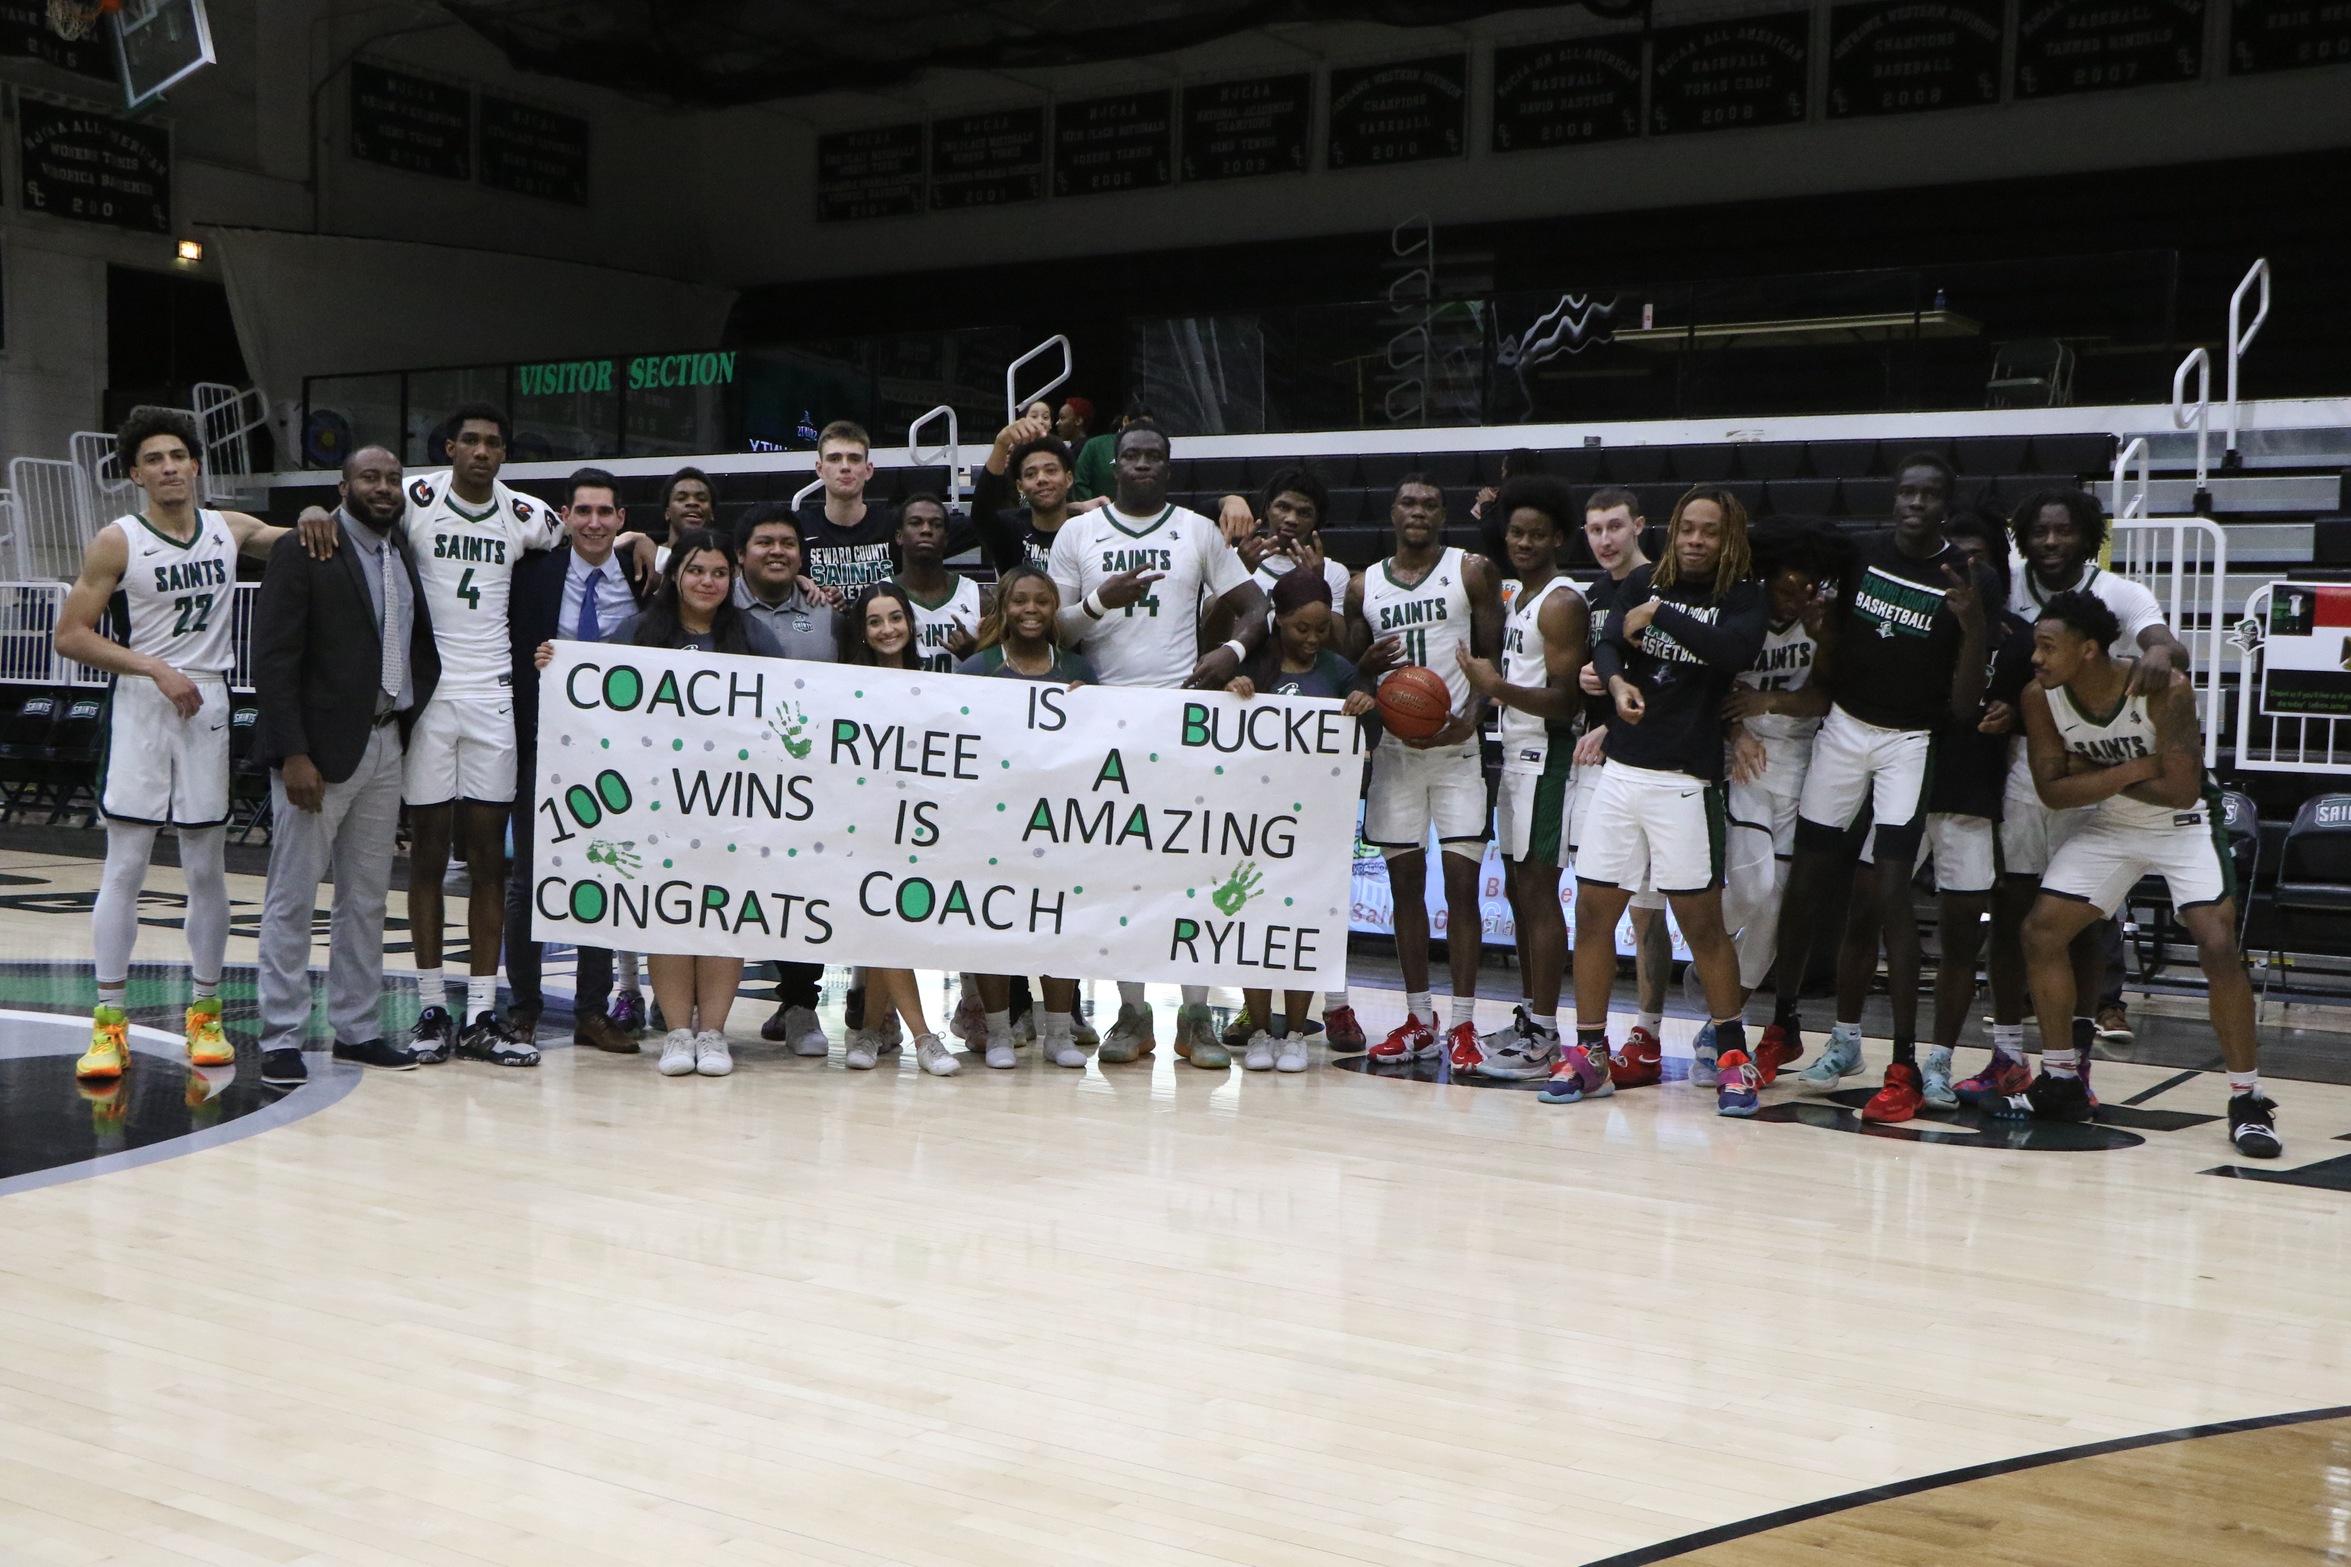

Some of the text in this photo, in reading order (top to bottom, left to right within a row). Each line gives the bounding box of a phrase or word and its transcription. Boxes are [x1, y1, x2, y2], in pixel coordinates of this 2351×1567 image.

[1886, 5, 1947, 22] WESTERN
[1949, 7, 2000, 42] DIVISION
[2067, 6, 2151, 30] BASEBALL
[1704, 29, 1730, 46] ALL
[1737, 27, 1805, 62] AMERICAN
[1875, 31, 1955, 52] CHAMPIONS
[1692, 53, 1768, 73] BASEBALL
[1873, 57, 1953, 78] BASEBALL
[2073, 62, 2138, 85] 2007
[1372, 69, 1420, 85] WESTERN
[1531, 72, 1604, 92] BASEBALL
[1734, 74, 1773, 91] CRUZ
[1220, 84, 1270, 101] NJCAA
[1363, 93, 1427, 112] CHAMPIONS
[1882, 87, 1942, 107] 2008
[1089, 102, 1137, 120] NJCAA
[1196, 107, 1239, 122] NATIONAL
[1519, 100, 1554, 114] DAVID
[1701, 104, 1753, 124] 2008
[1216, 116, 1272, 132] CHAMPIONS
[1358, 115, 1431, 134] BASEBALL
[1541, 121, 1592, 141] 2008
[73, 120, 102, 134] ALL
[104, 128, 167, 176] MERIAN
[1372, 141, 1418, 160] 2010
[102, 151, 139, 170] TNIS
[1223, 159, 1266, 173] 2009
[519, 351, 736, 396] VISITOR SECTION
[434, 533, 506, 565] SAINTS
[810, 542, 890, 565] SEWARD COUNTY
[1102, 549, 1171, 572] SAINTS
[154, 558, 226, 593] SAINTS
[810, 559, 895, 587] SAINTS
[457, 568, 480, 609] 4
[172, 593, 214, 637] 22
[1380, 597, 1447, 630] SAINTS
[1855, 591, 1933, 632] BASKETBALL
[1406, 629, 1427, 667] 11
[1641, 635, 1709, 666] ASKETB
[1755, 642, 1811, 672] AINTS
[24, 700, 51, 715] SAINTS
[70, 703, 99, 718] SAINTS
[566, 663, 764, 718] COACH
[830, 718, 981, 780] RYLEE
[1027, 686, 1067, 732] IS
[1092, 748, 1129, 794] A
[2074, 735, 2149, 761] SAINTS
[538, 767, 1298, 858] 100 WINS IS AMAZING
[536, 871, 1320, 972] CONGRATS COACH RYLEE
